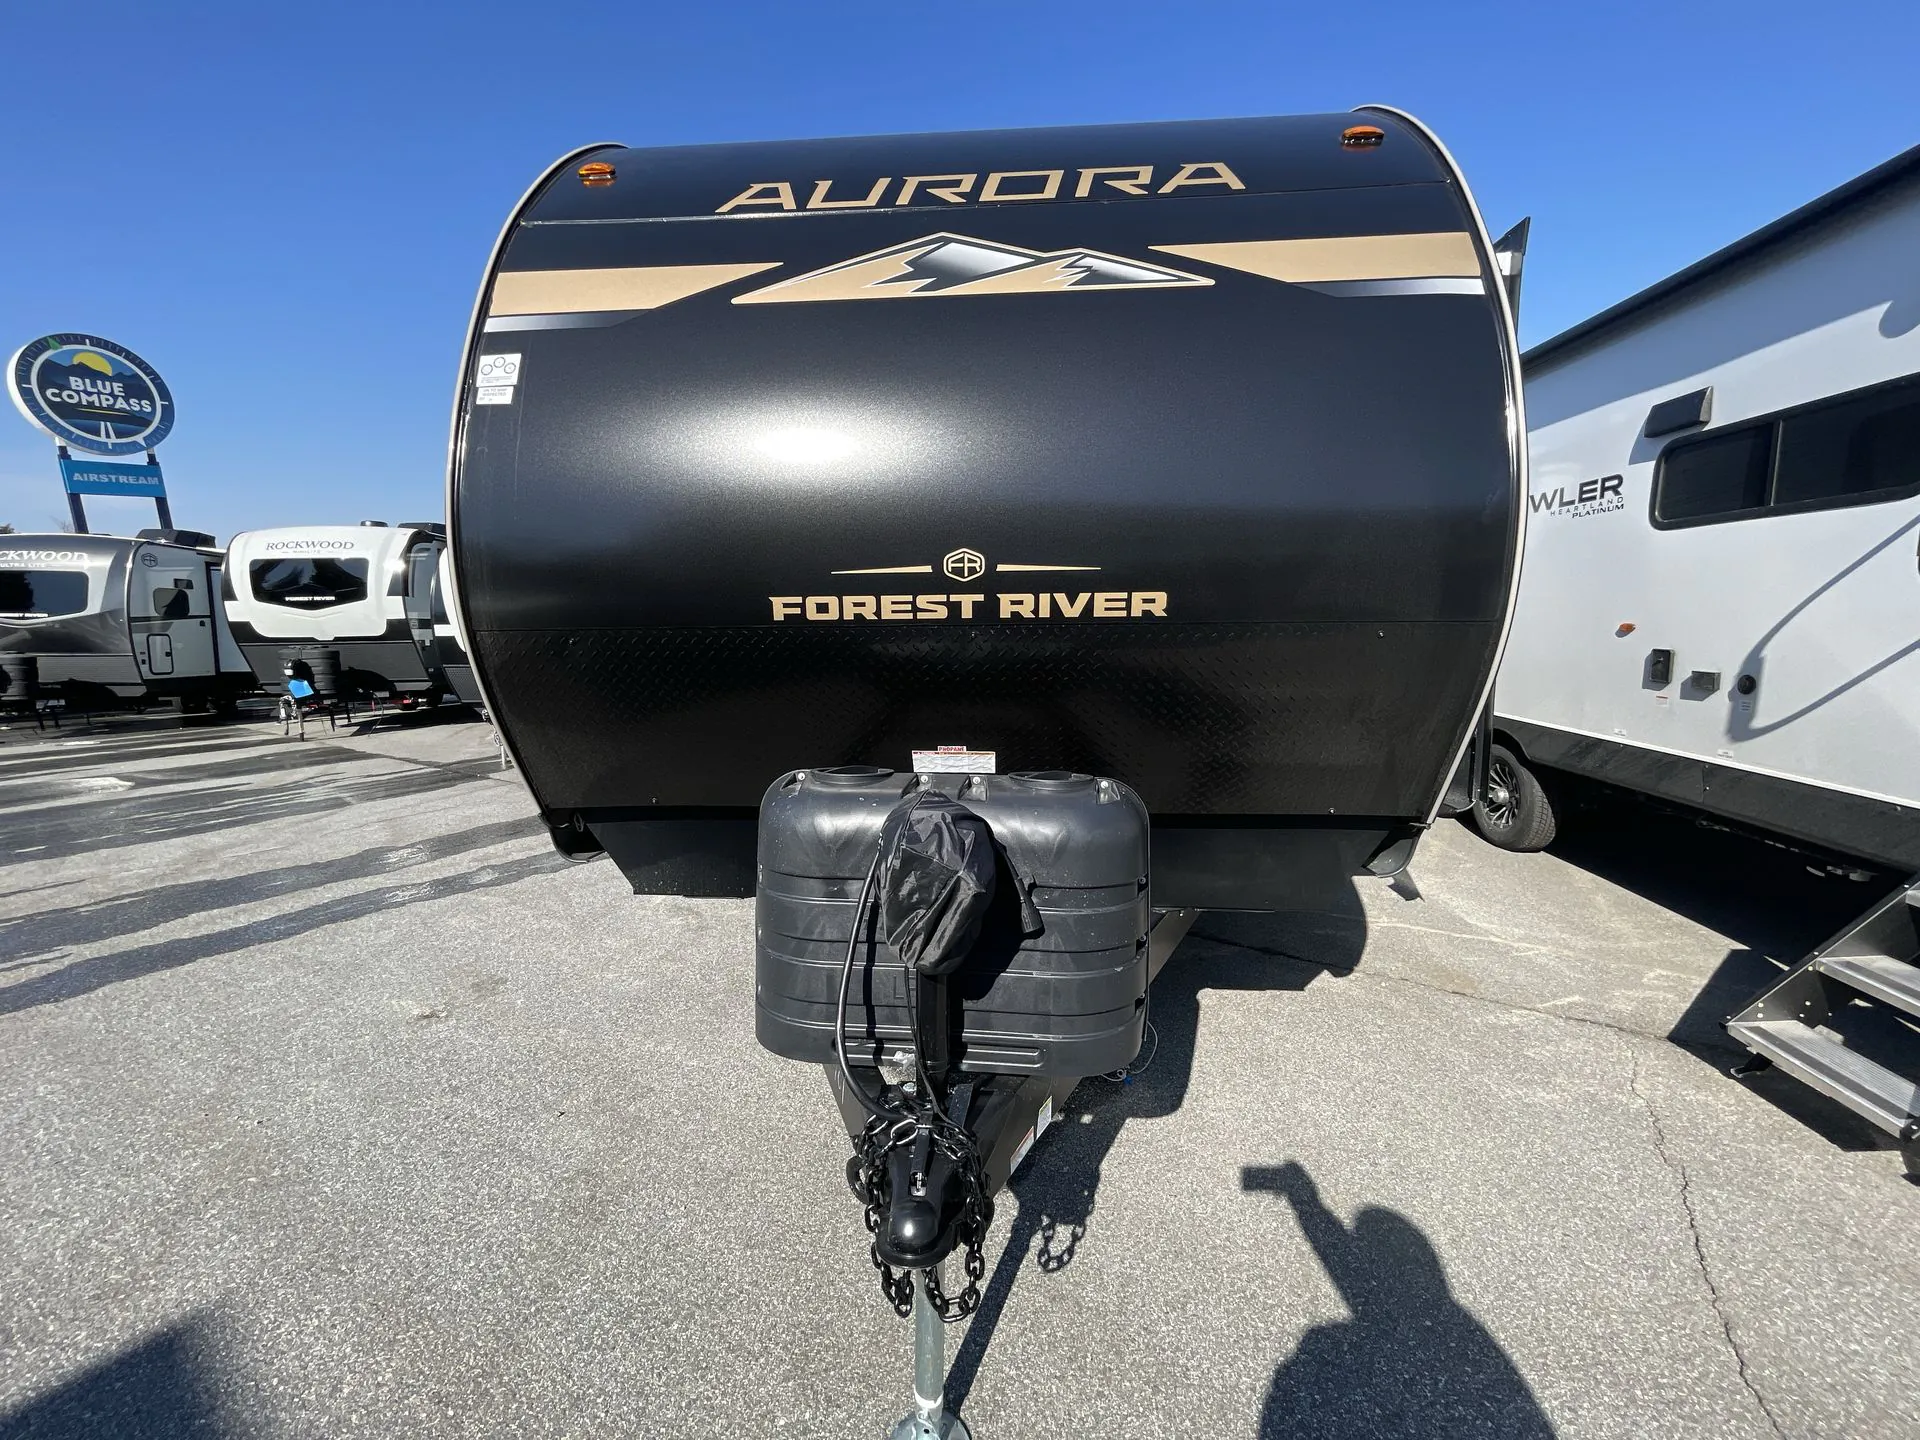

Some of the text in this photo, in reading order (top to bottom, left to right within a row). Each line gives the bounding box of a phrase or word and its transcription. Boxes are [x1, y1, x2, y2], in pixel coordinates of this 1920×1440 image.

[715, 162, 1246, 213] AURORA
[69, 376, 125, 397] BLUE
[45, 388, 153, 413] COMPASS
[72, 472, 160, 486] AIRSTREAM
[1529, 473, 1624, 514] WLER
[1550, 496, 1624, 517] HEARTLAND
[1571, 503, 1625, 519] PLATINUM
[266, 540, 355, 550] ROCKWOOD
[769, 591, 1168, 622] FOREST RIVER
